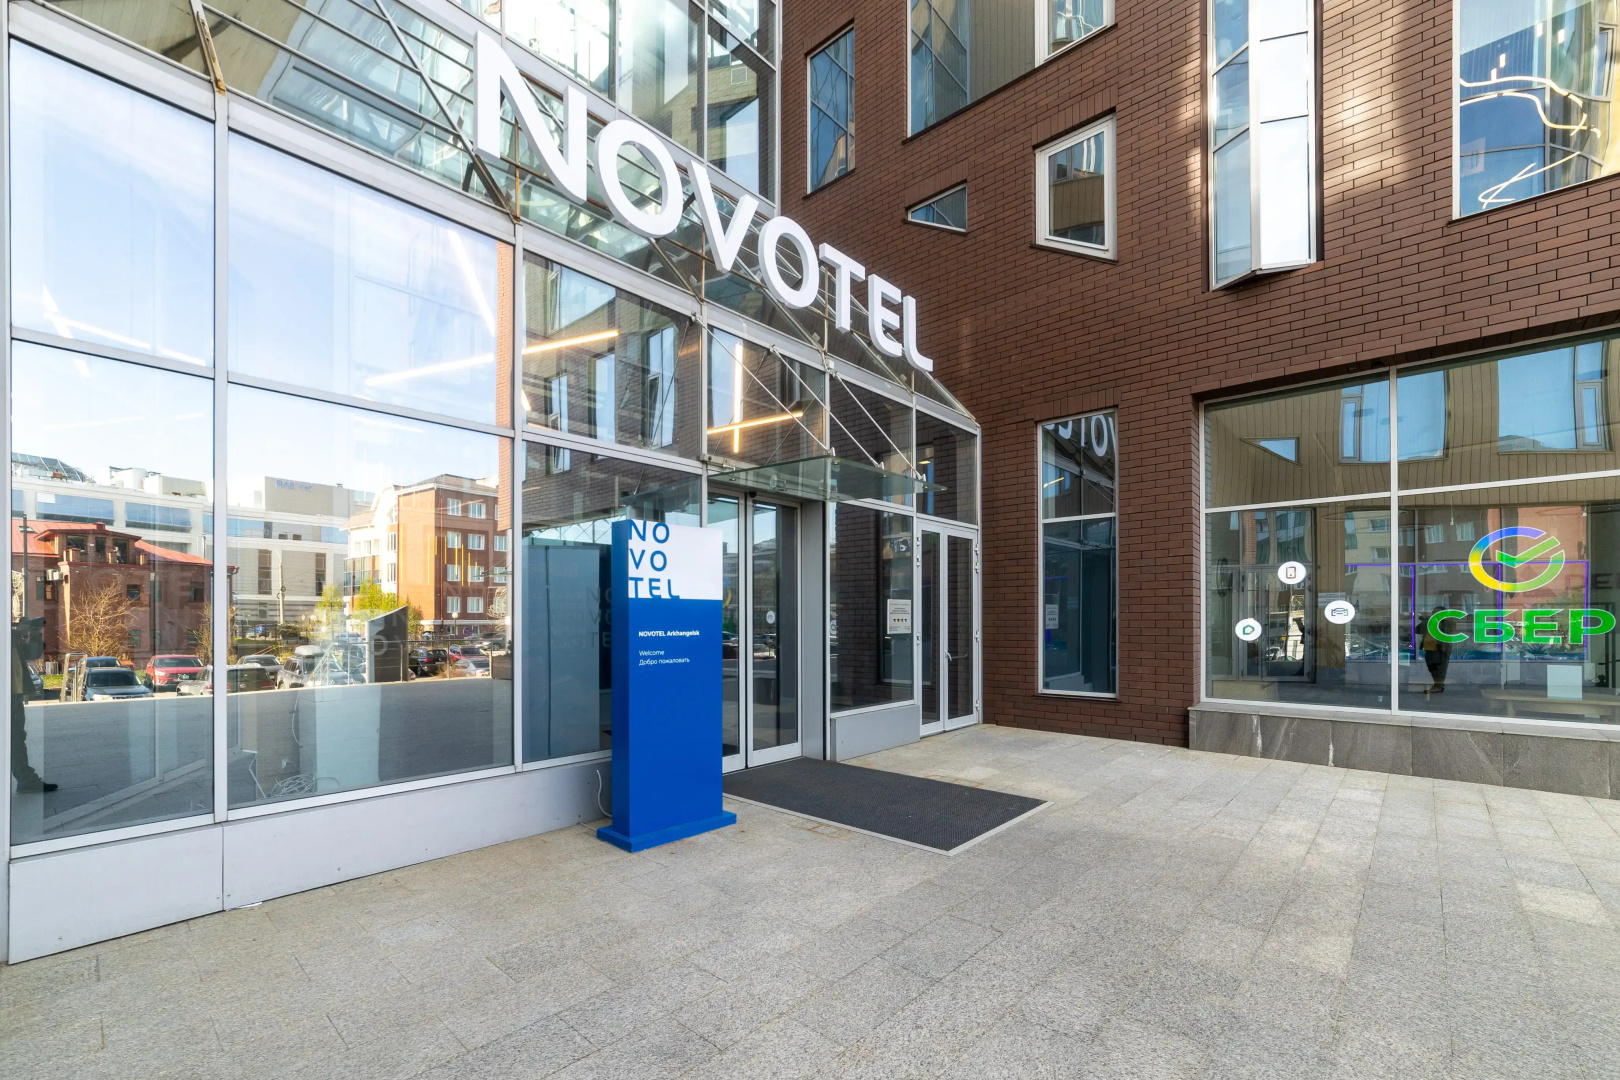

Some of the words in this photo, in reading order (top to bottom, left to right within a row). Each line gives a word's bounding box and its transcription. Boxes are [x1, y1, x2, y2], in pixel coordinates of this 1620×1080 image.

[473, 30, 933, 372] NOVOTEL
[628, 519, 670, 544] NO
[629, 548, 667, 572] VO
[628, 577, 680, 599] TEL
[666, 629, 700, 637] Arkhangelsk
[1427, 609, 1616, 644] СБЕР
[638, 658, 658, 666] Добро
[658, 657, 690, 665] пожаловать
